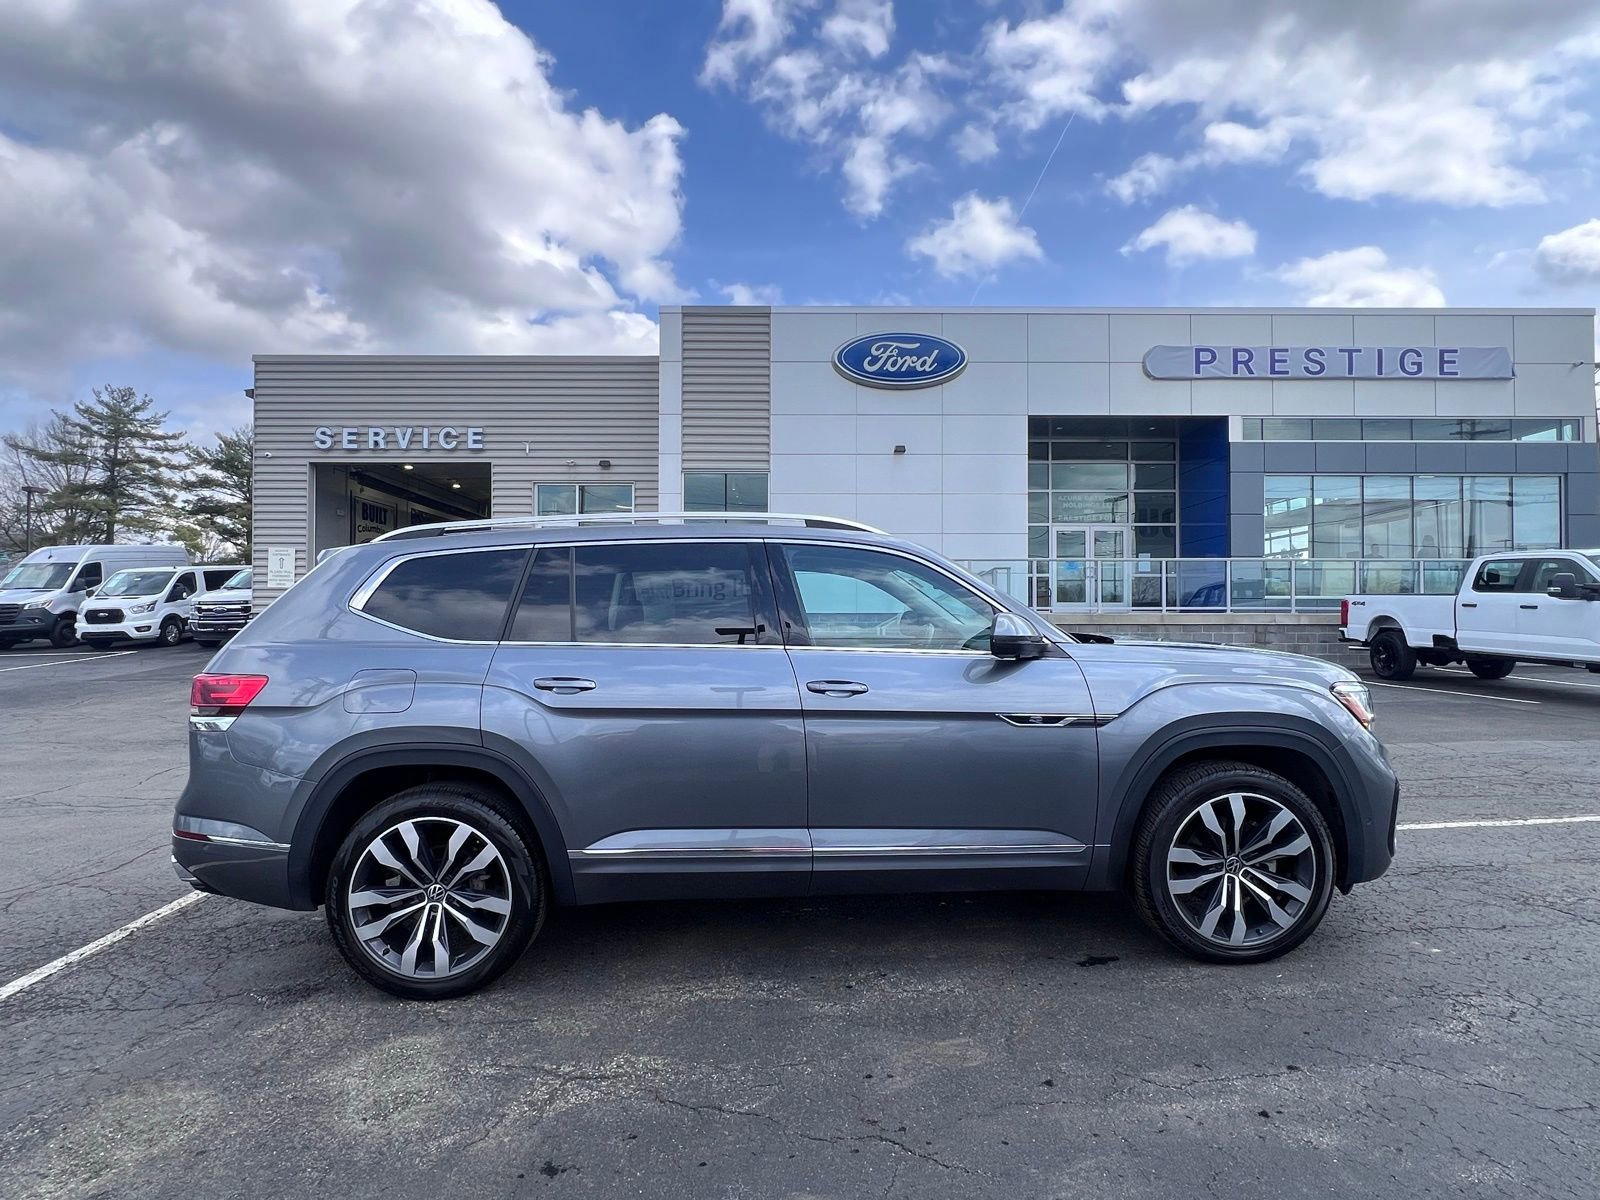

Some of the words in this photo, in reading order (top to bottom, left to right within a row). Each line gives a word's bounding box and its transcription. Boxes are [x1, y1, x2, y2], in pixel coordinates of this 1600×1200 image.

[863, 341, 939, 372] Ford
[1194, 347, 1459, 376] PRESTIGE
[314, 426, 484, 450] SERVICE
[361, 502, 388, 525] BUILT
